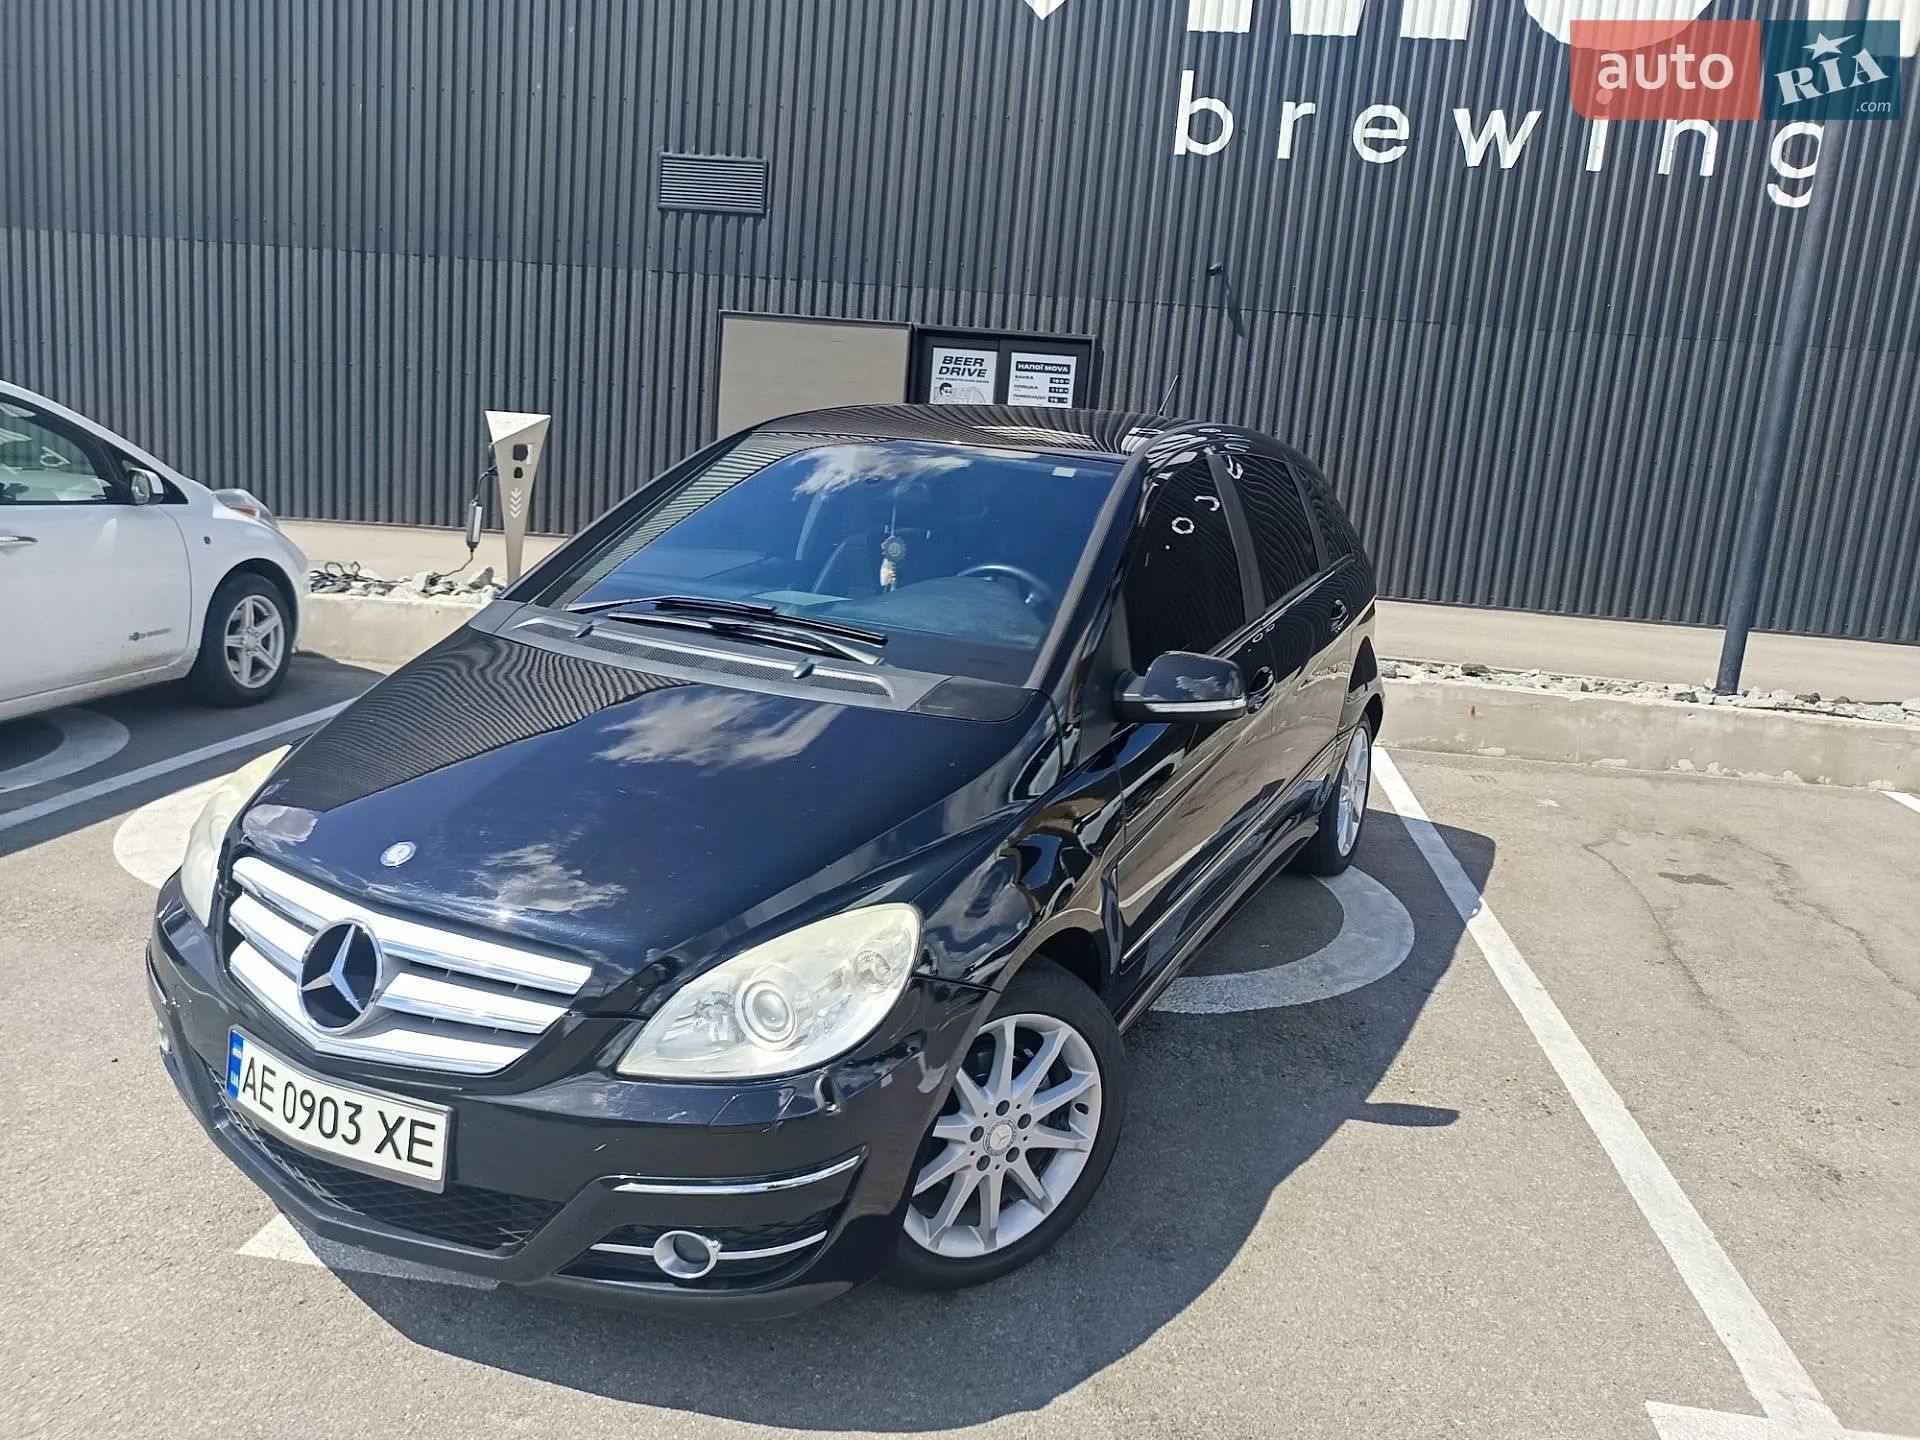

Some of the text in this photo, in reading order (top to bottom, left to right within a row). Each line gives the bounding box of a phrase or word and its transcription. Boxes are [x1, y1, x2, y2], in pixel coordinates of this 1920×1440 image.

[1174, 70, 1825, 208] brewing
[942, 355, 985, 367] BEER
[938, 366, 988, 378] DRIVE
[1044, 365, 1069, 373] MOVA
[242, 1056, 436, 1168] AE 0903 XE
